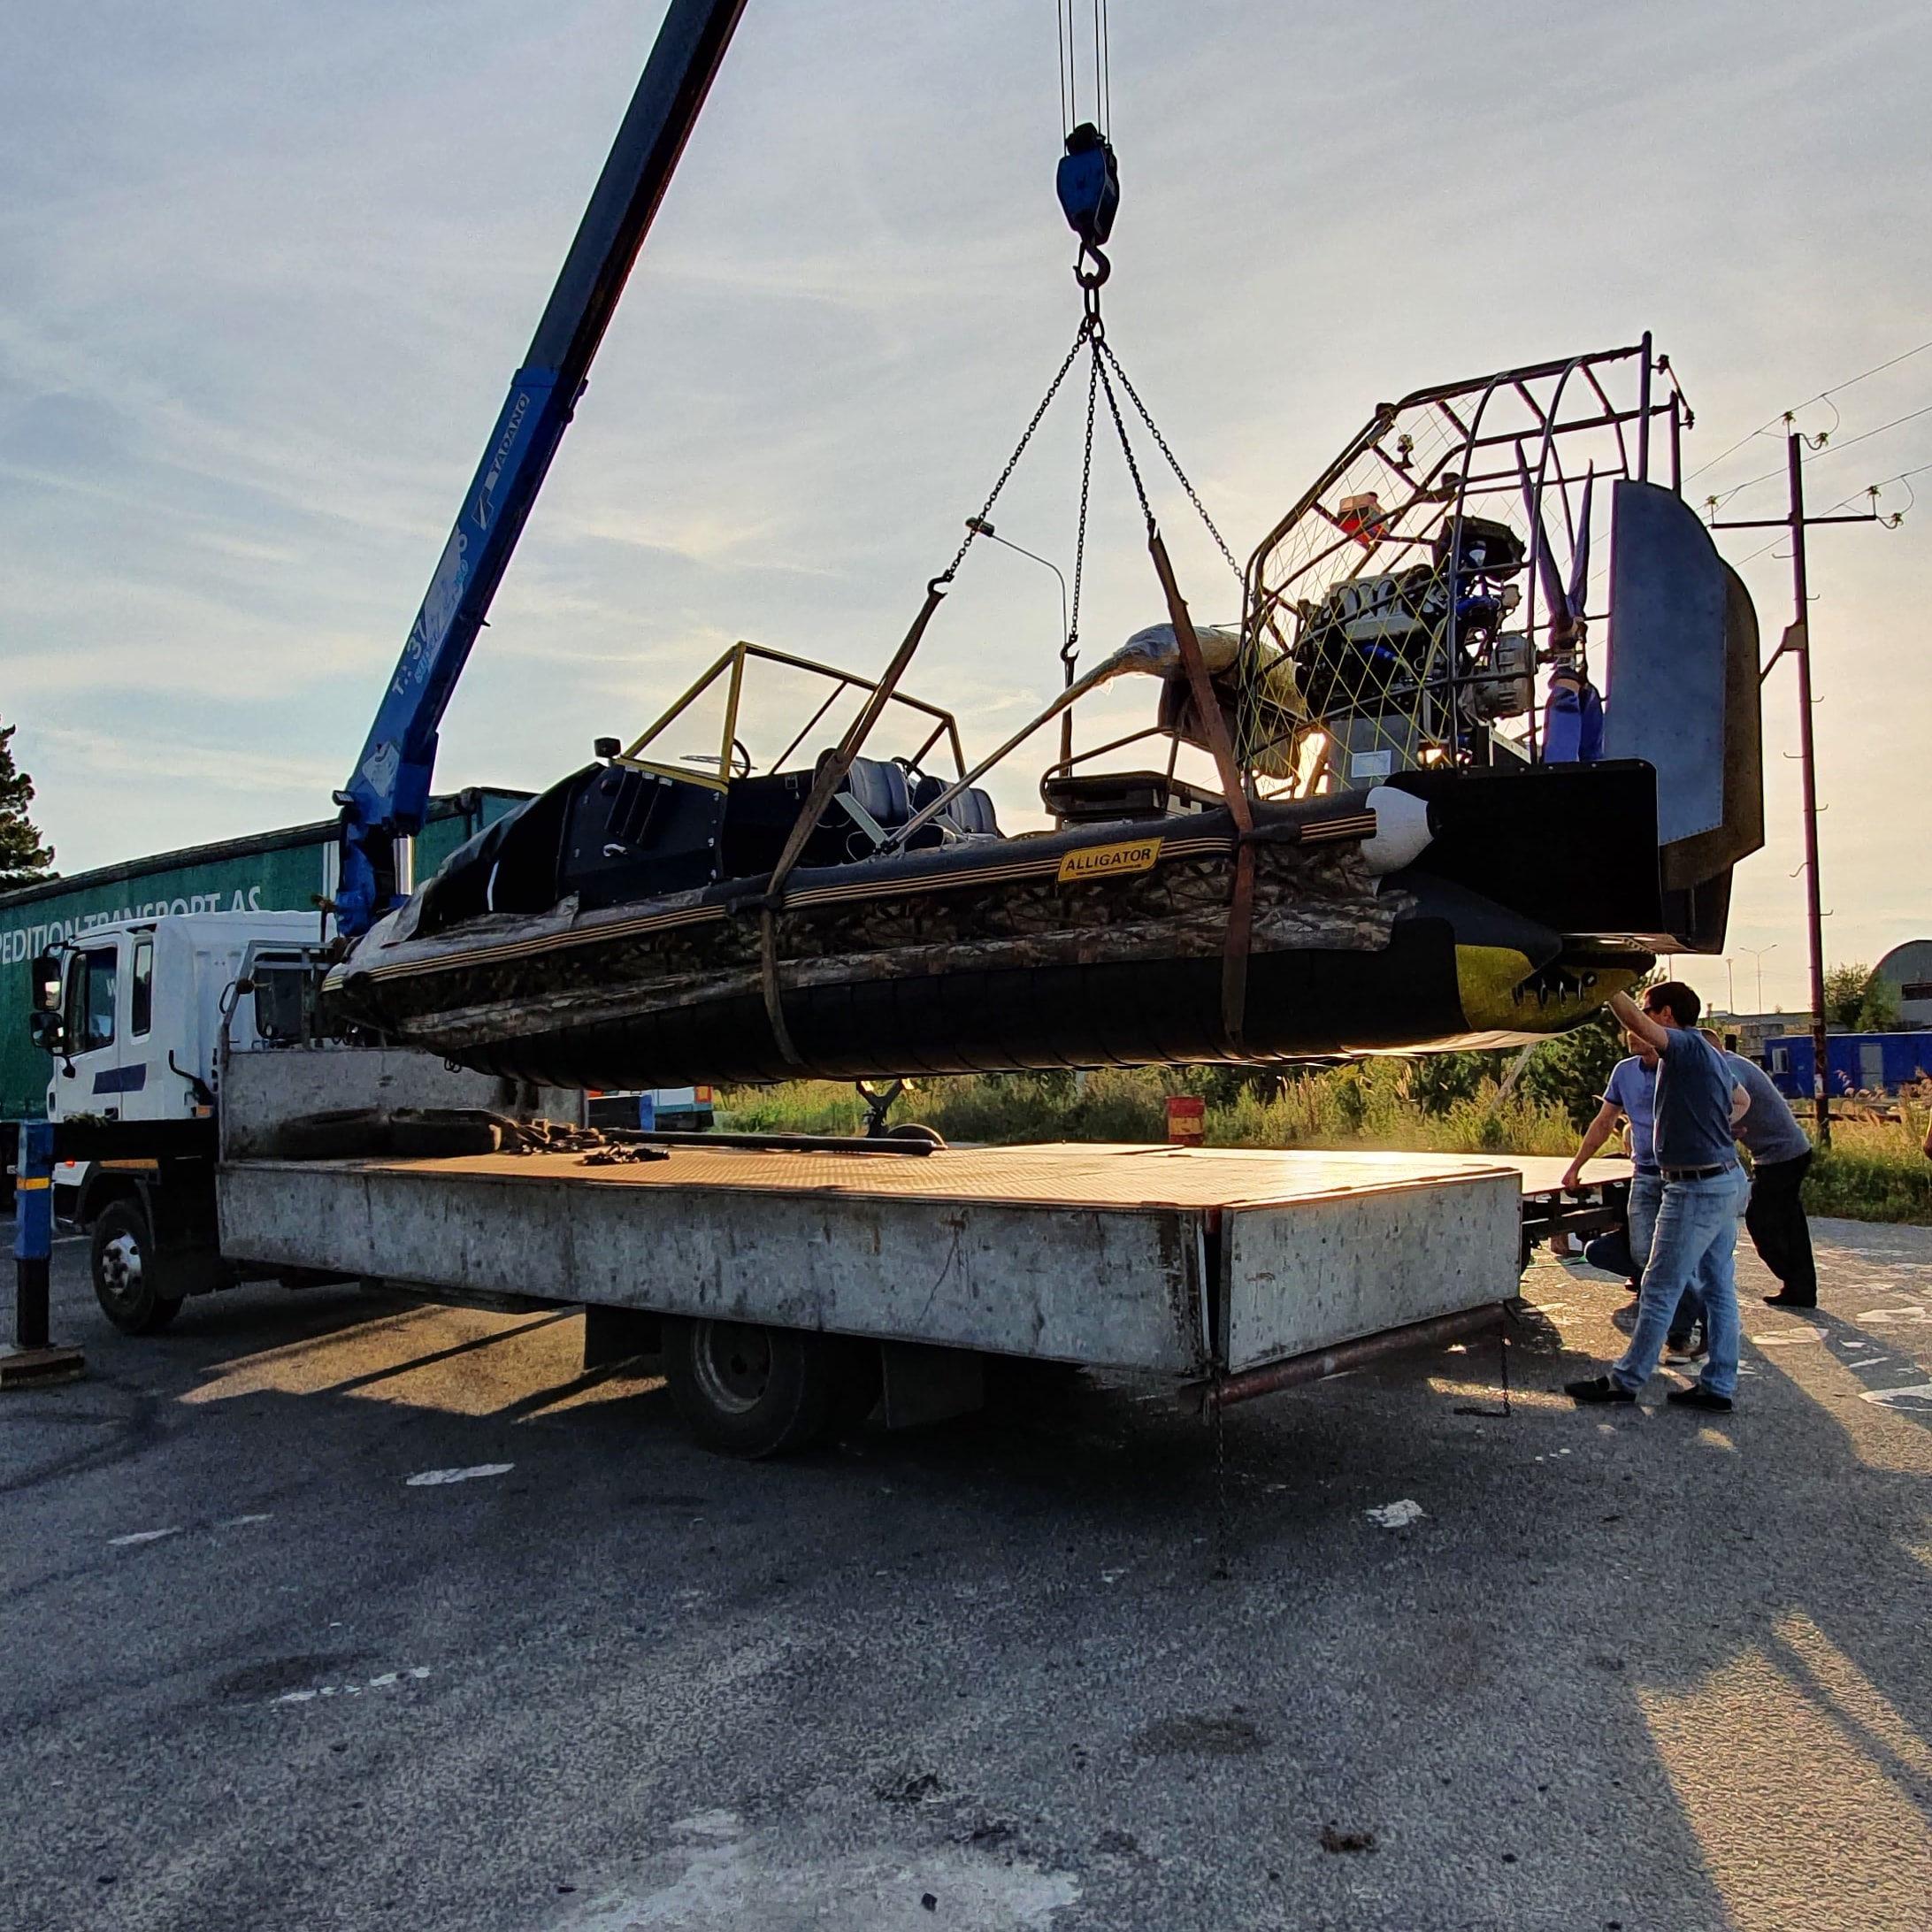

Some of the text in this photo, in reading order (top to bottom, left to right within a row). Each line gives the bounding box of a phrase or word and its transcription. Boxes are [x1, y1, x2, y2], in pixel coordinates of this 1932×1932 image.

[491, 393, 531, 474] TADANO
[1064, 847, 1152, 871] ALLIGATOR
[0, 916, 80, 965] EDITION
